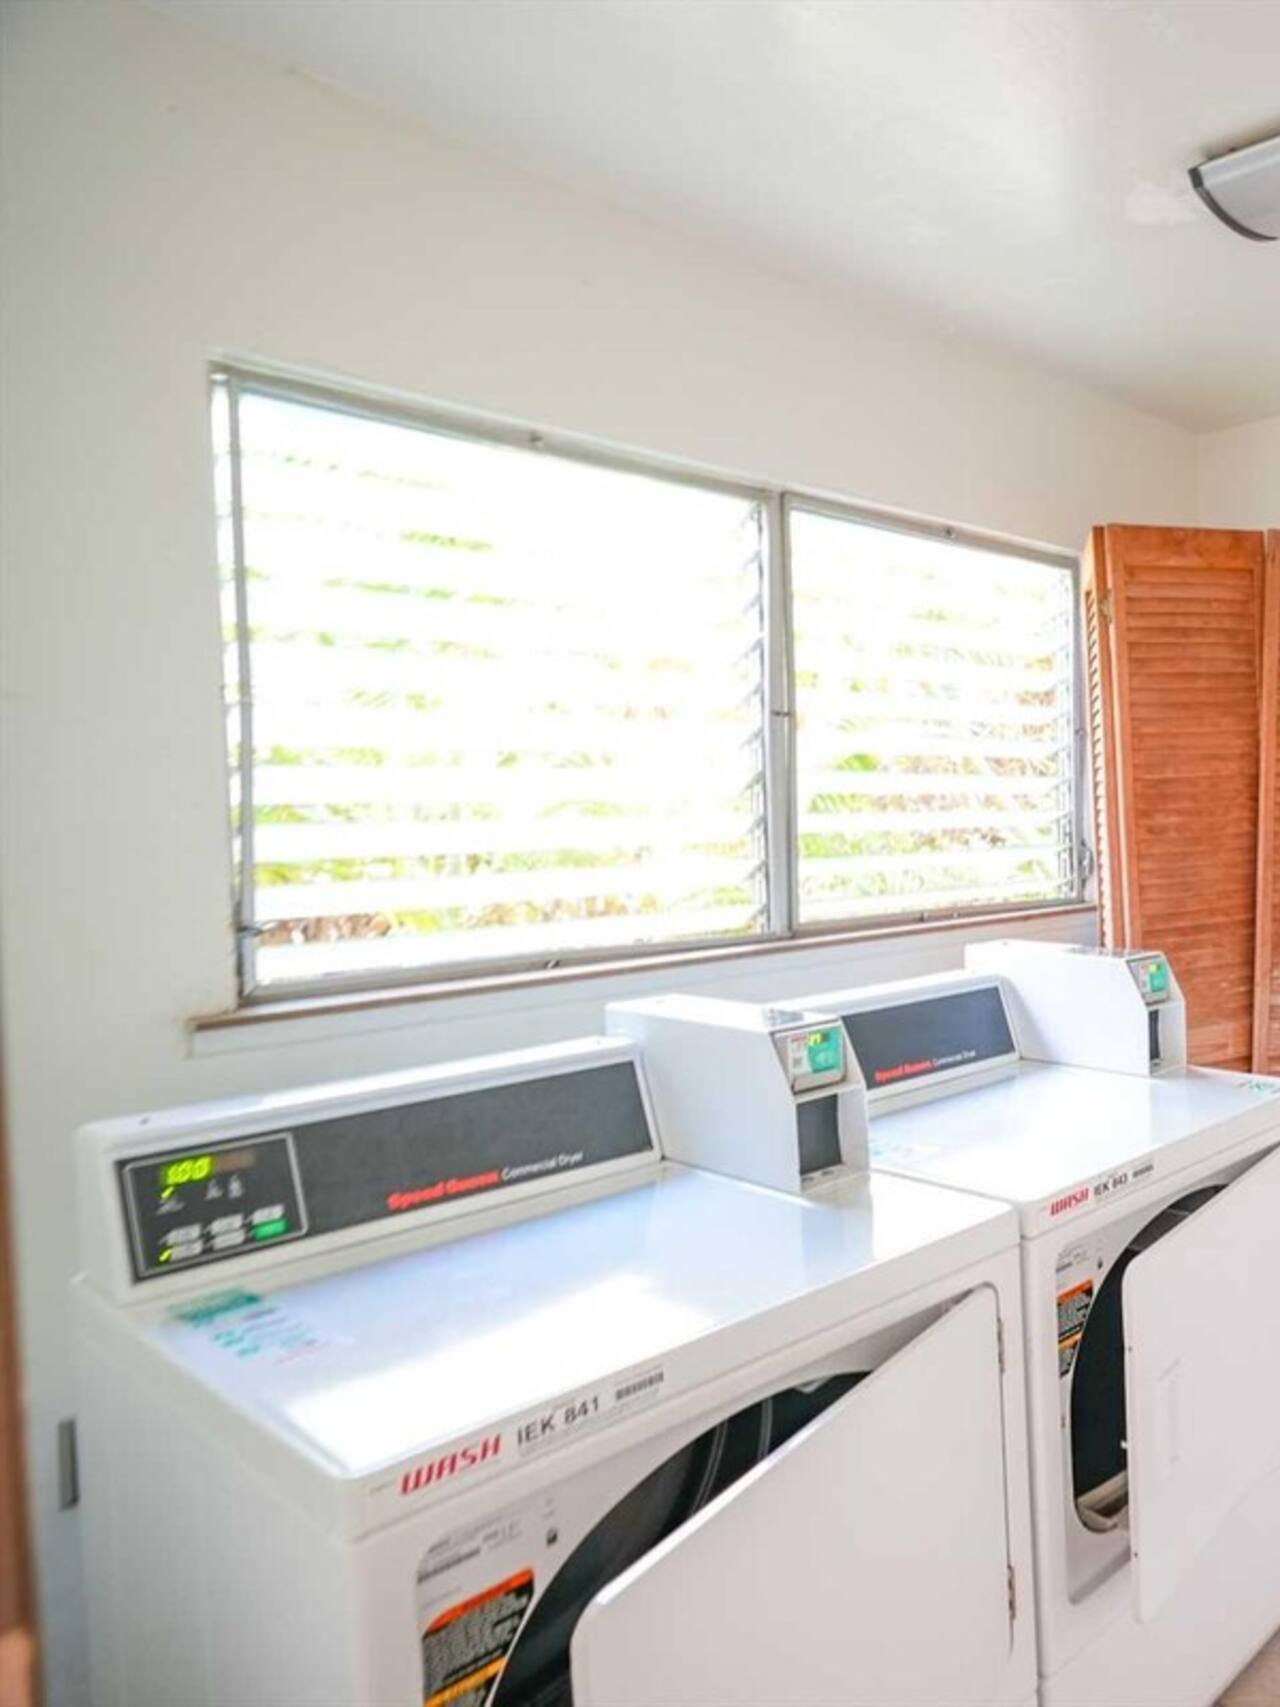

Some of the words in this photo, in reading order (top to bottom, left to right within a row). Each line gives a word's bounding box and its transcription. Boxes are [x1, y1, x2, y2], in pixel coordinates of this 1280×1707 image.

[501, 1156, 557, 1181] Commercial
[558, 1151, 584, 1167] Dryer
[1050, 1187, 1090, 1217] WASH
[401, 1432, 502, 1497] WASH
[516, 1415, 557, 1447] IEK
[563, 1396, 601, 1425] 841
